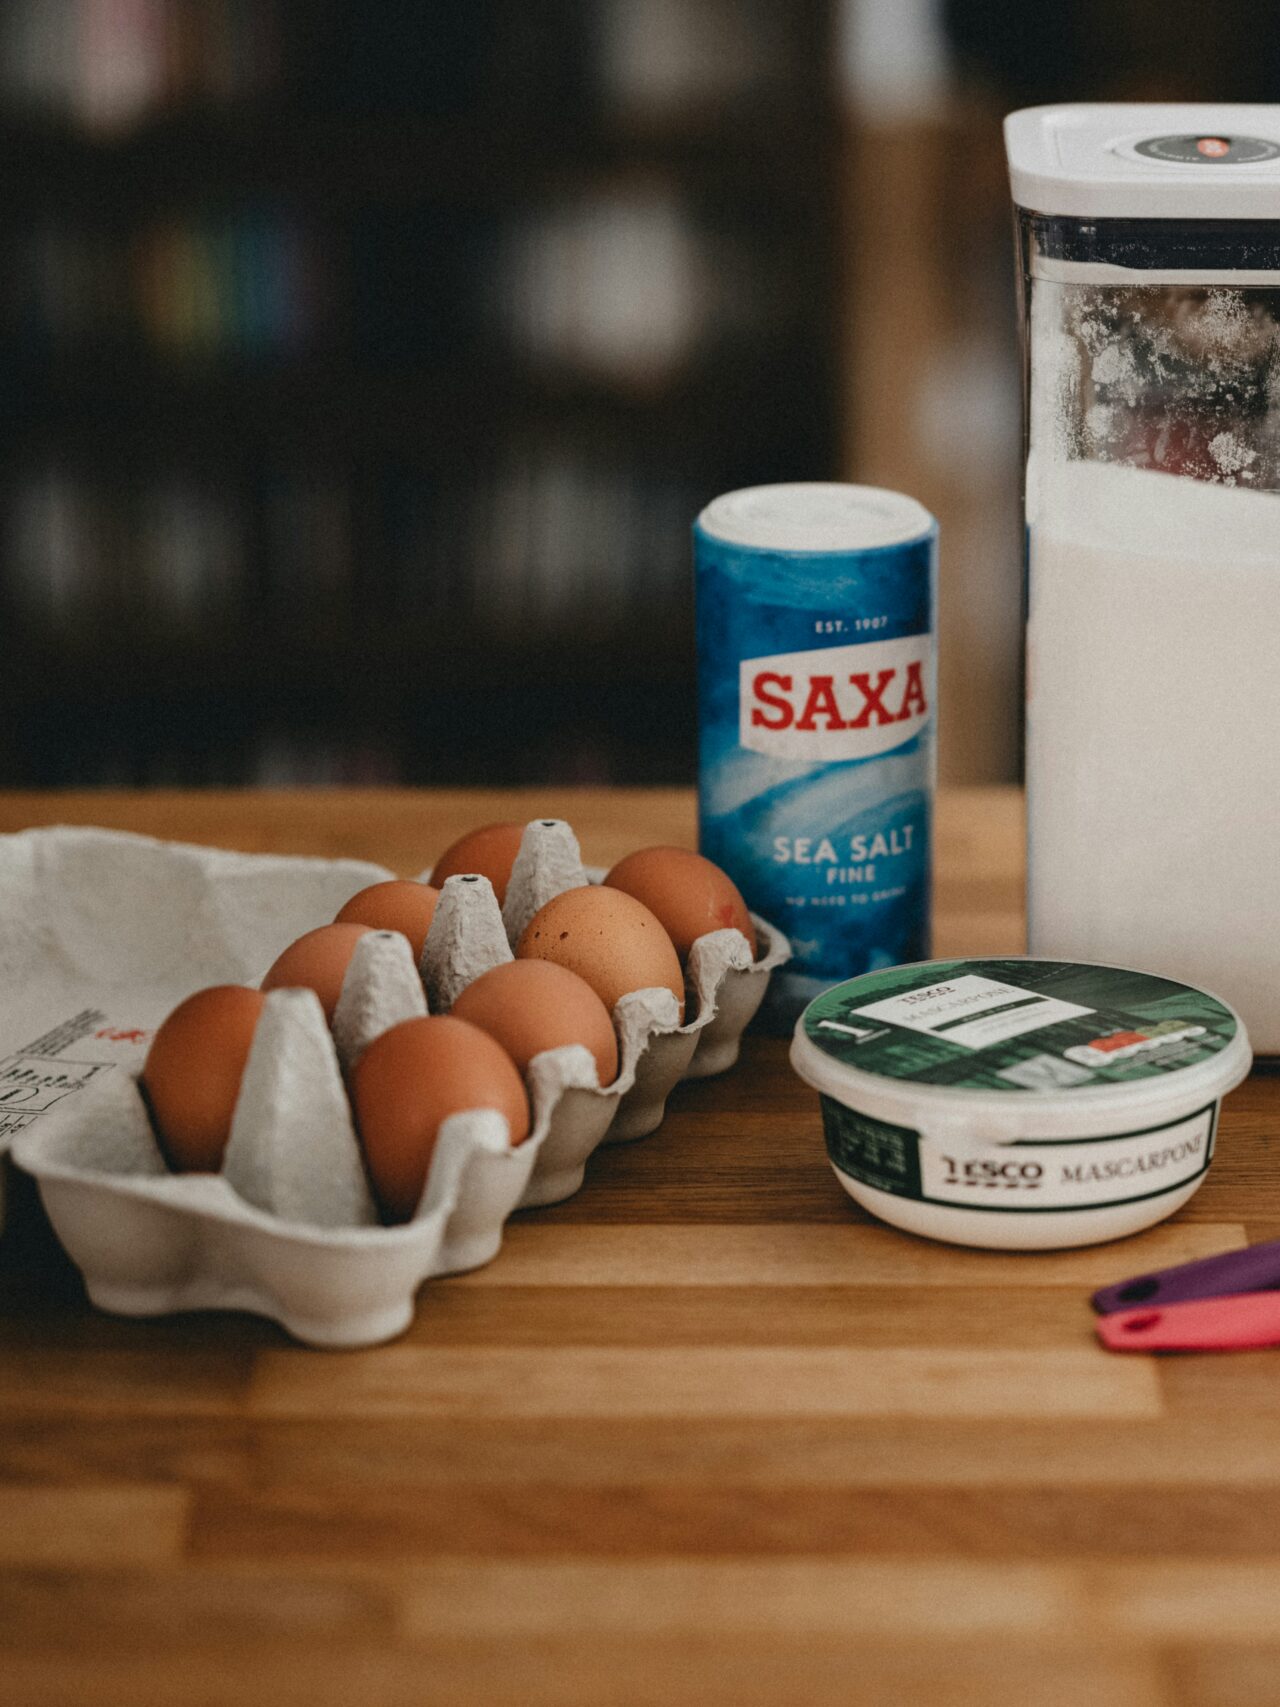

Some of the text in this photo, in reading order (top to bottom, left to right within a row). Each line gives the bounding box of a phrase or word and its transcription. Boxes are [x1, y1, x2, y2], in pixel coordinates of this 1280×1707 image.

[855, 616, 888, 631] 1907
[751, 661, 928, 731] SAXA
[773, 825, 914, 864] SEA SALT
[827, 864, 876, 885] FINE
